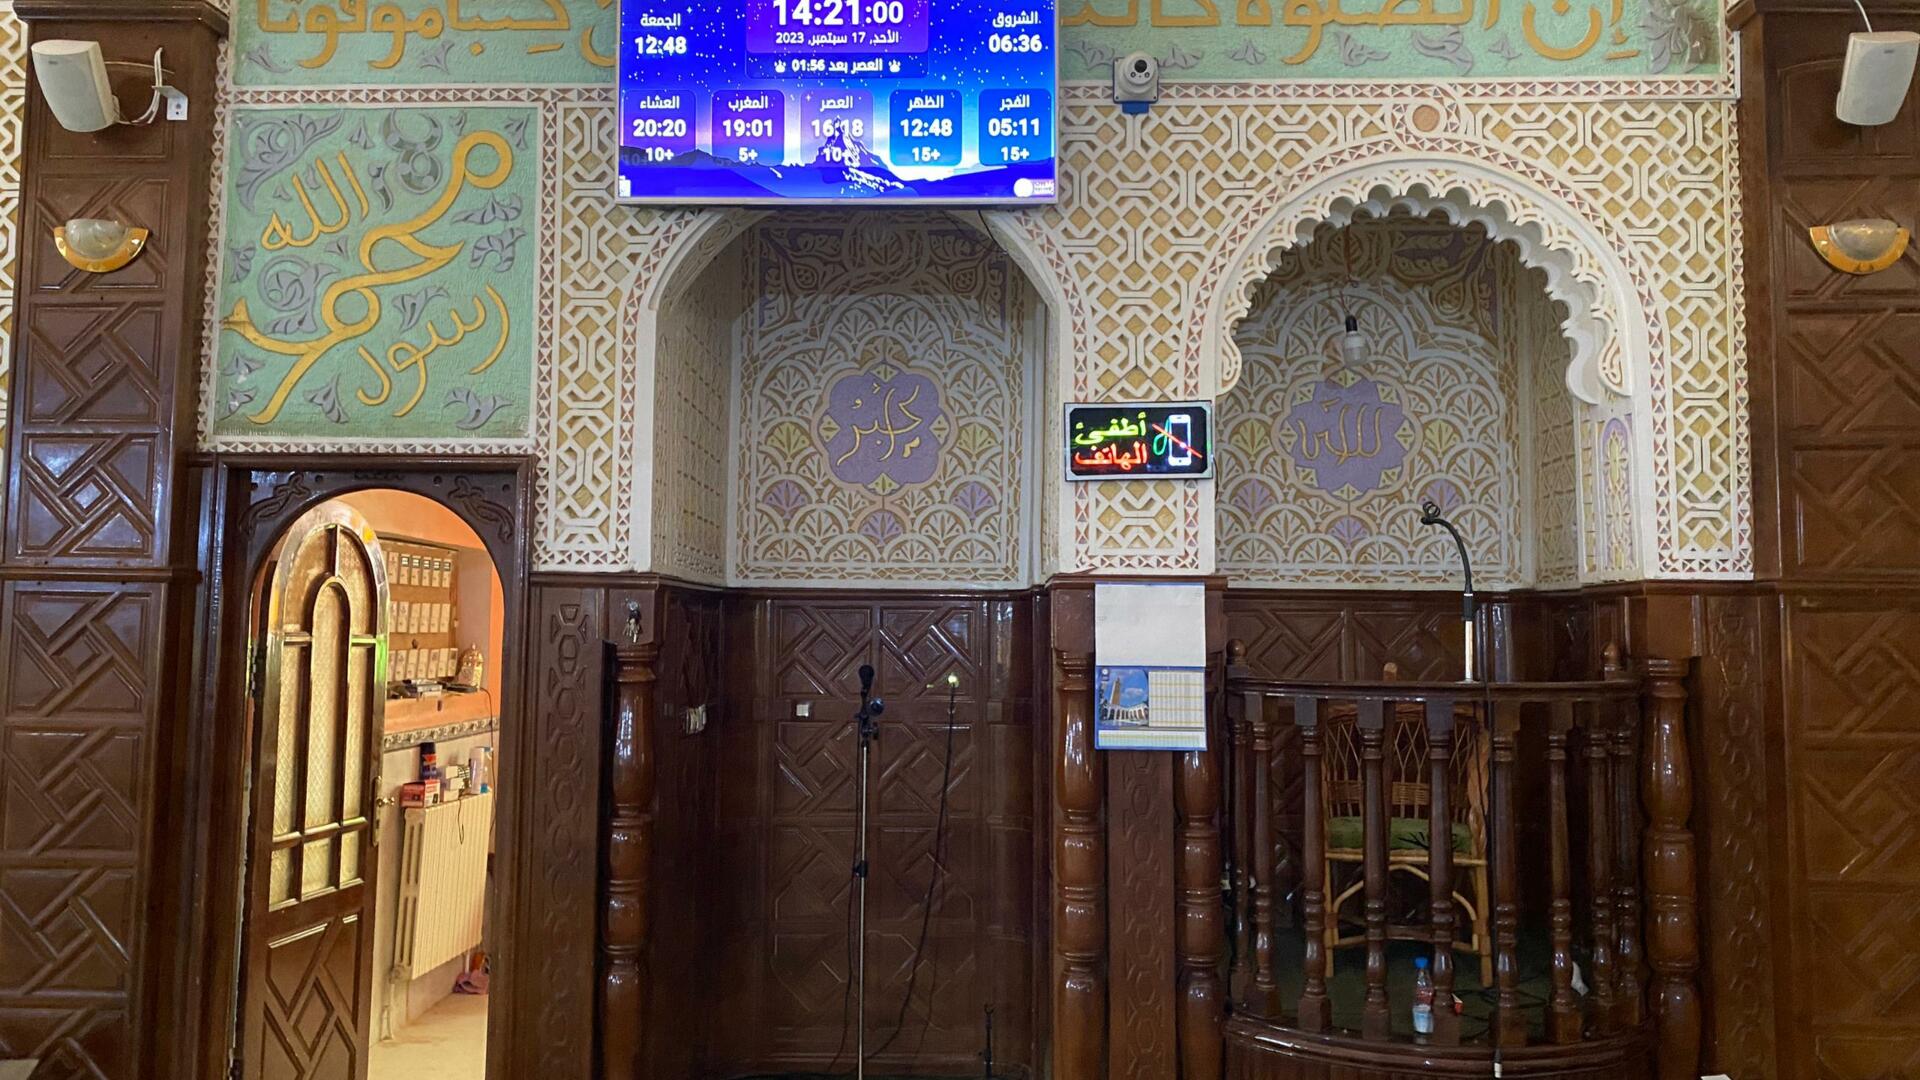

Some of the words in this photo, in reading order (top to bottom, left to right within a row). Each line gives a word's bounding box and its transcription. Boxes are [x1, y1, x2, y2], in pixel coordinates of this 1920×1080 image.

[640, 12, 682, 30] الجمعة
[772, 0, 904, 26] 14:21:00
[992, 10, 1039, 28] الشروق
[634, 35, 687, 55] 12:48
[775, 32, 805, 44] 2023
[852, 32, 866, 44] 17
[988, 33, 1043, 53] 06:36
[791, 58, 826, 72] 01:56
[828, 62, 848, 74] بعد
[850, 57, 883, 74] العصر
[639, 95, 680, 110] العشاء
[728, 95, 768, 112] المغرب
[820, 95, 854, 112] العصر
[907, 95, 944, 112] الظهر
[999, 94, 1030, 112] الفجر
[632, 118, 687, 137] 20:20
[722, 118, 773, 137] 19:01
[811, 118, 864, 137] 16:18
[900, 118, 953, 137] 12:48
[988, 117, 1040, 136] 05:11
[260, 150, 369, 250] الله
[1074, 440, 1148, 471] الهاتف
